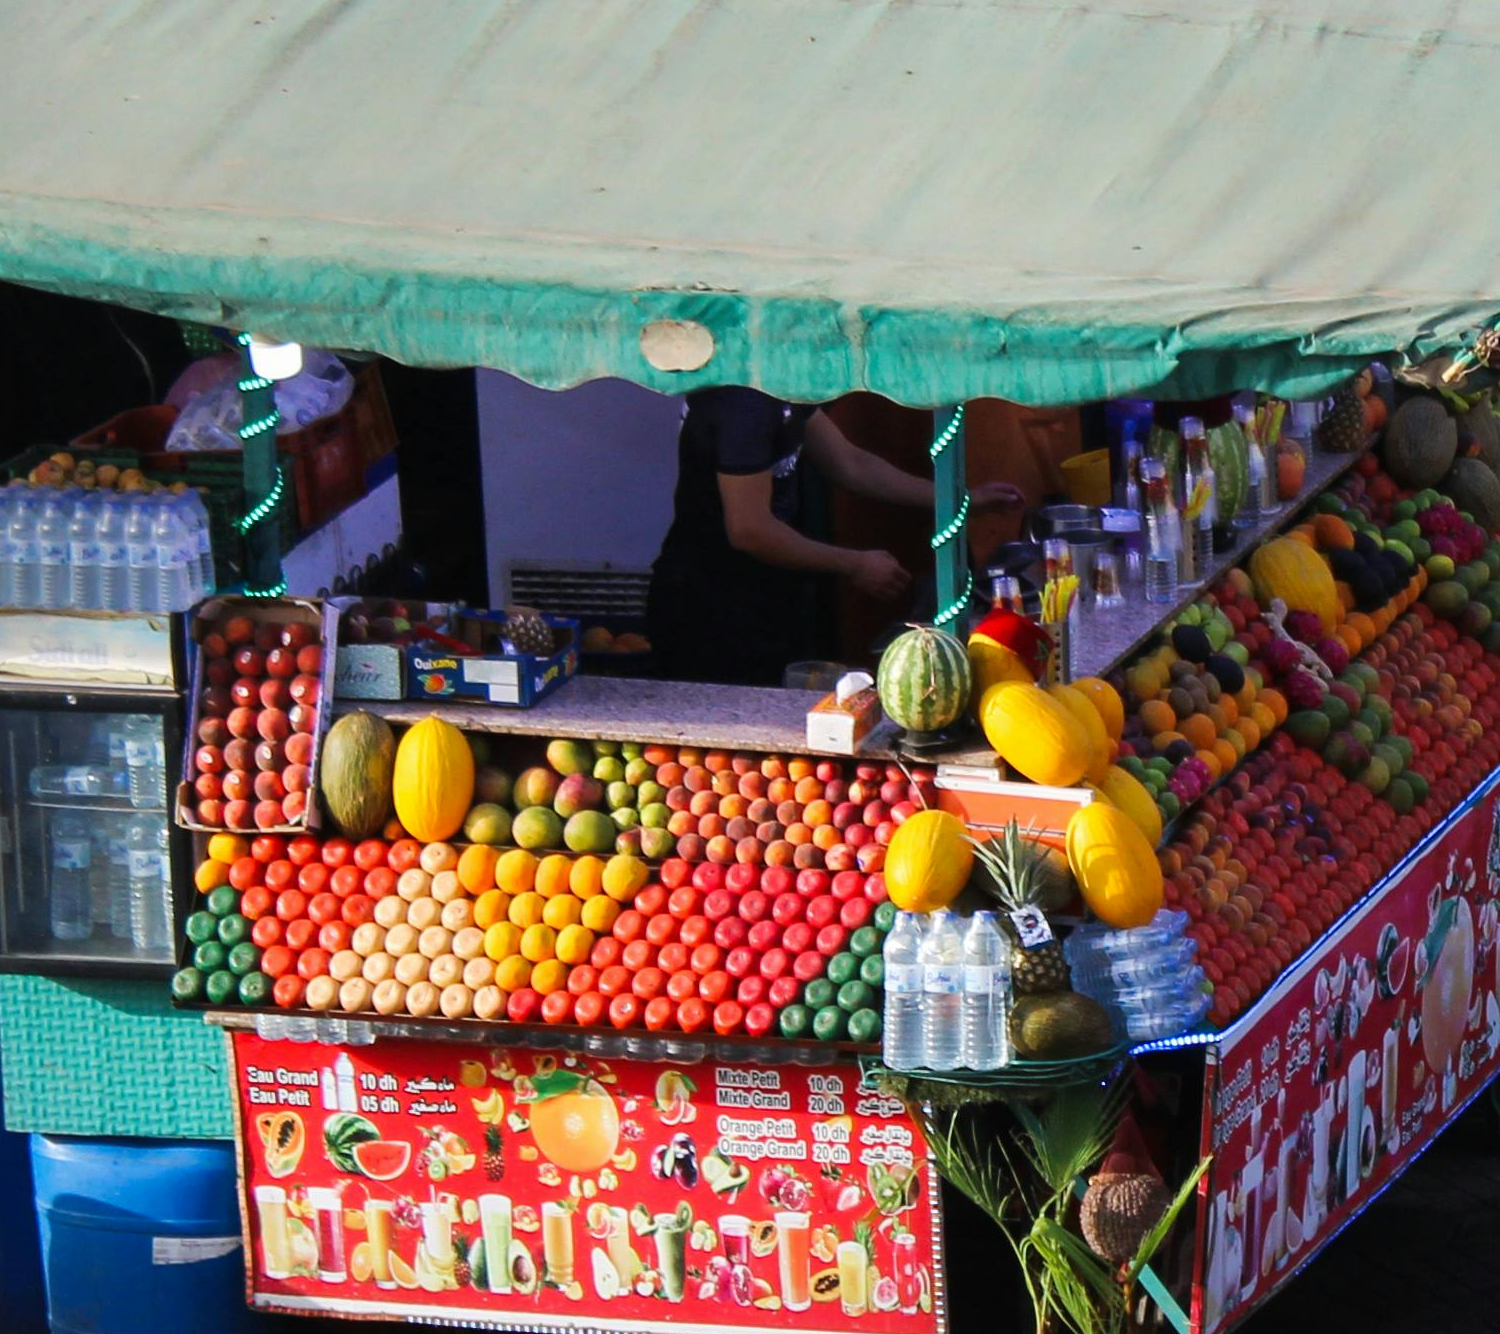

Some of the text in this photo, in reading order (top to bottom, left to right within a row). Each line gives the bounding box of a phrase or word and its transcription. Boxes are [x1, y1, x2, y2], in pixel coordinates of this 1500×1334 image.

[246, 1066, 318, 1086] Eau Grand
[360, 1073, 398, 1091] 10 dh
[716, 1067, 779, 1088] Mixte Petit
[808, 1075, 825, 1092] 10
[825, 1076, 843, 1094] dh
[249, 1087, 310, 1106] Eau Petit
[361, 1095, 399, 1113] 05 dh
[717, 1088, 790, 1110] Mixte Grand
[808, 1094, 844, 1114] 20 dh
[718, 1115, 796, 1138] Orange Petit
[812, 1123, 849, 1143] 10 dh
[719, 1137, 807, 1160] Orange Grand
[812, 1144, 850, 1163] 20 dh
